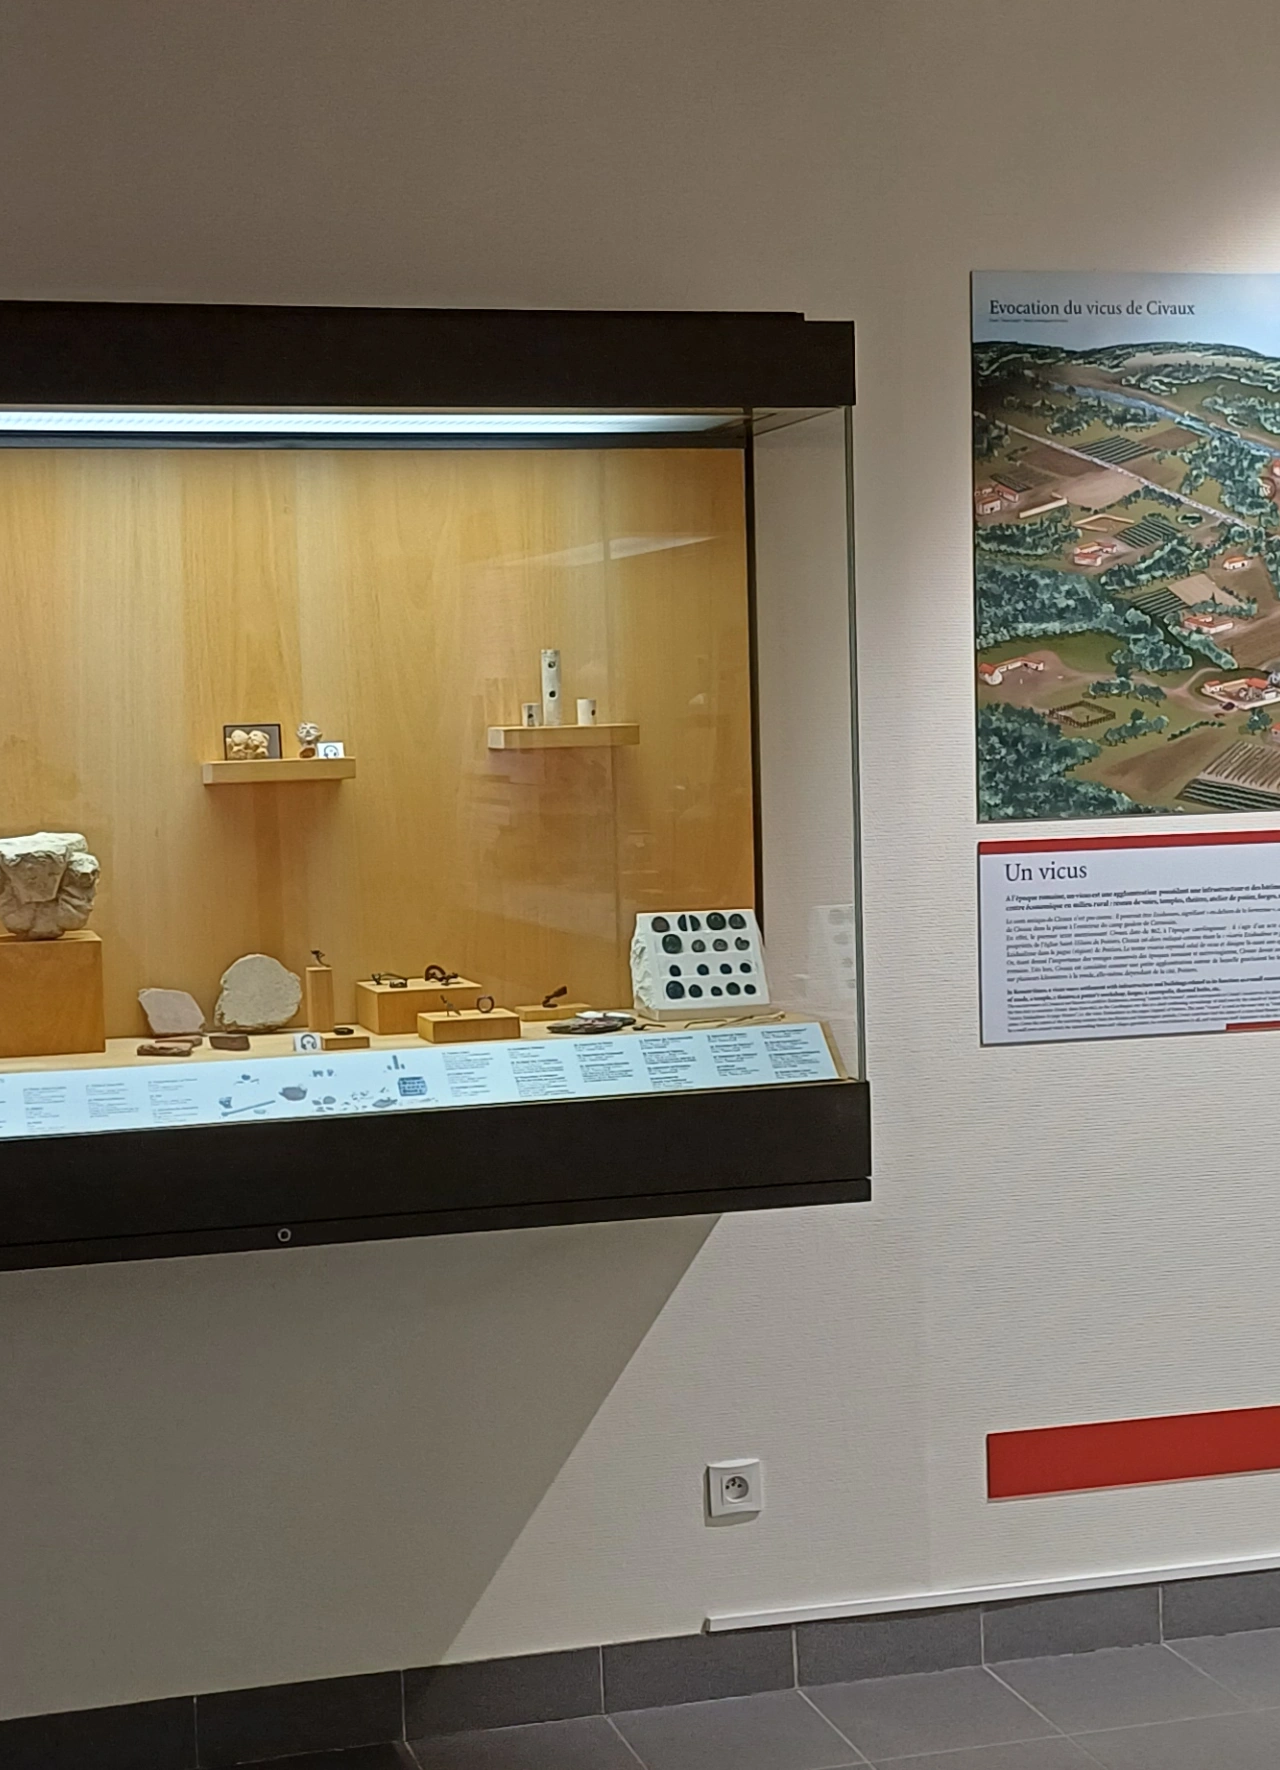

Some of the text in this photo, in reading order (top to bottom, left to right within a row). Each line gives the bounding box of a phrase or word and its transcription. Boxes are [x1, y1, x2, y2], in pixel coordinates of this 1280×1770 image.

[989, 299, 1196, 316] Evocation du vicus de Civaux
[1005, 860, 1088, 881] Un vicus
